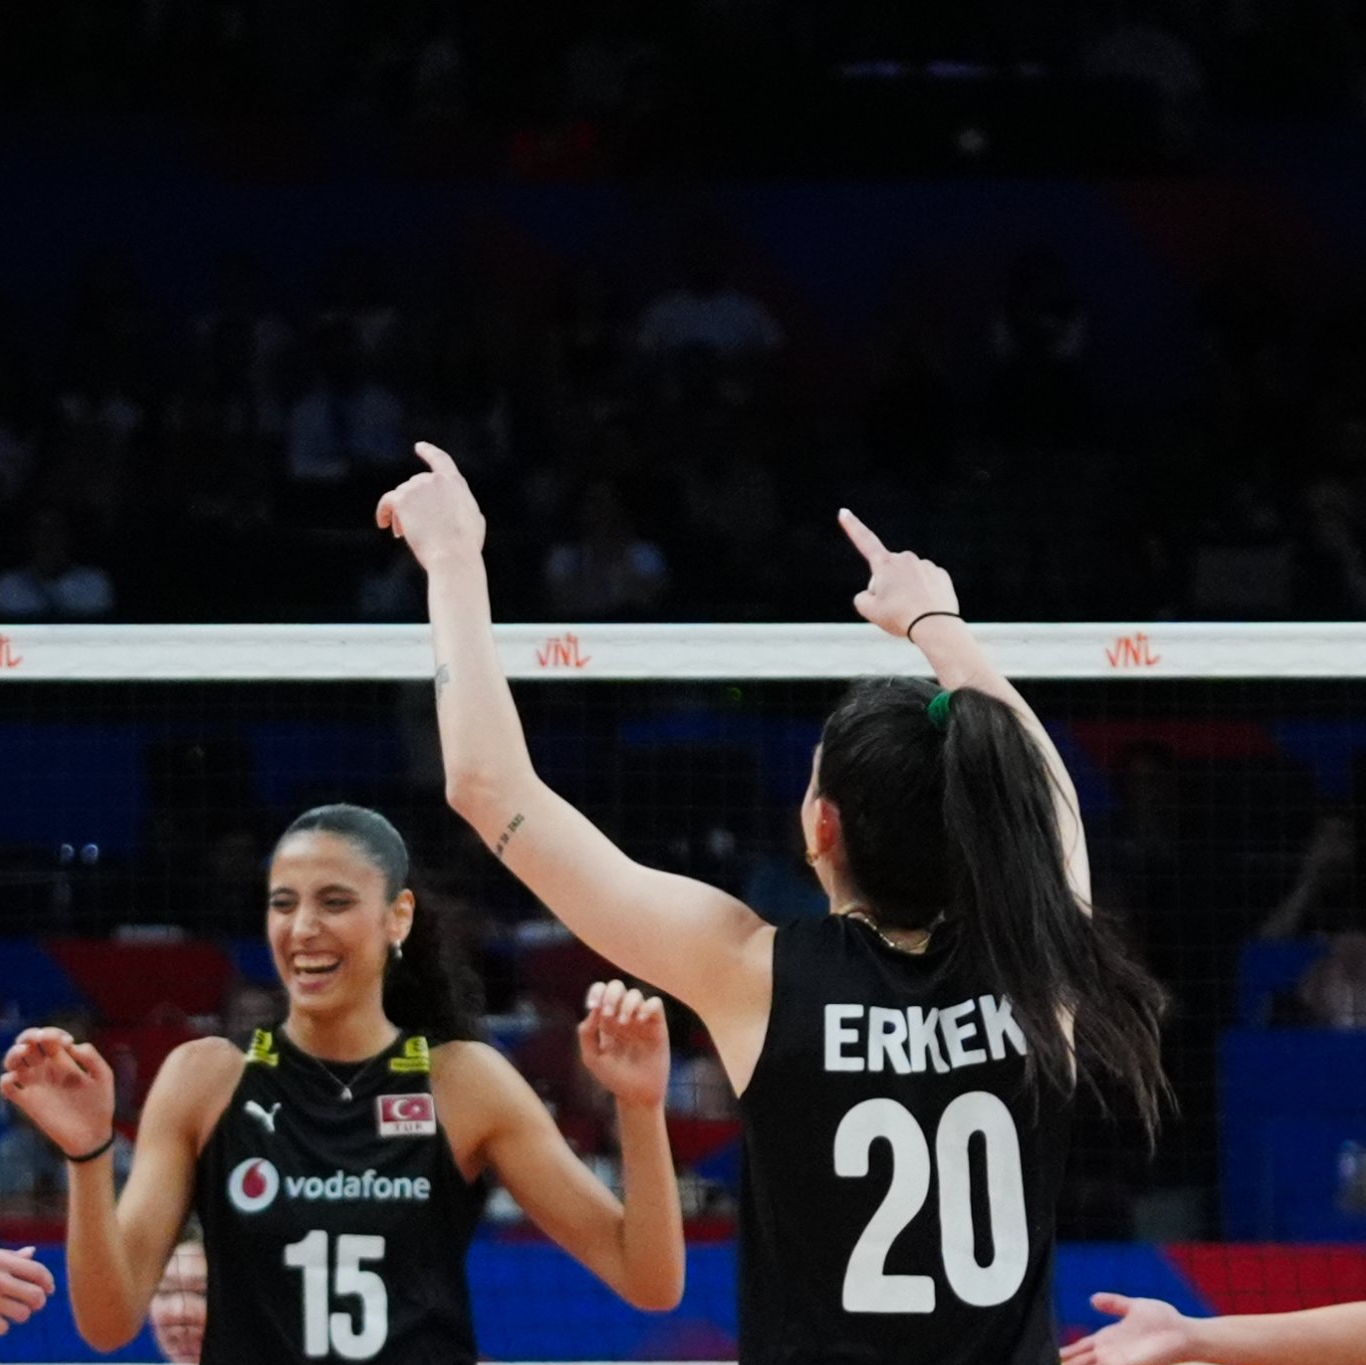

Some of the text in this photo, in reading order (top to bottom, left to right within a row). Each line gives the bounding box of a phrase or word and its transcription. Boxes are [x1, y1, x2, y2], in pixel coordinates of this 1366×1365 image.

[824, 994, 1028, 1074] ERKEK
[286, 1168, 432, 1201] vodafone
[834, 1090, 1029, 1314] 20
[284, 1229, 388, 1360] 15
